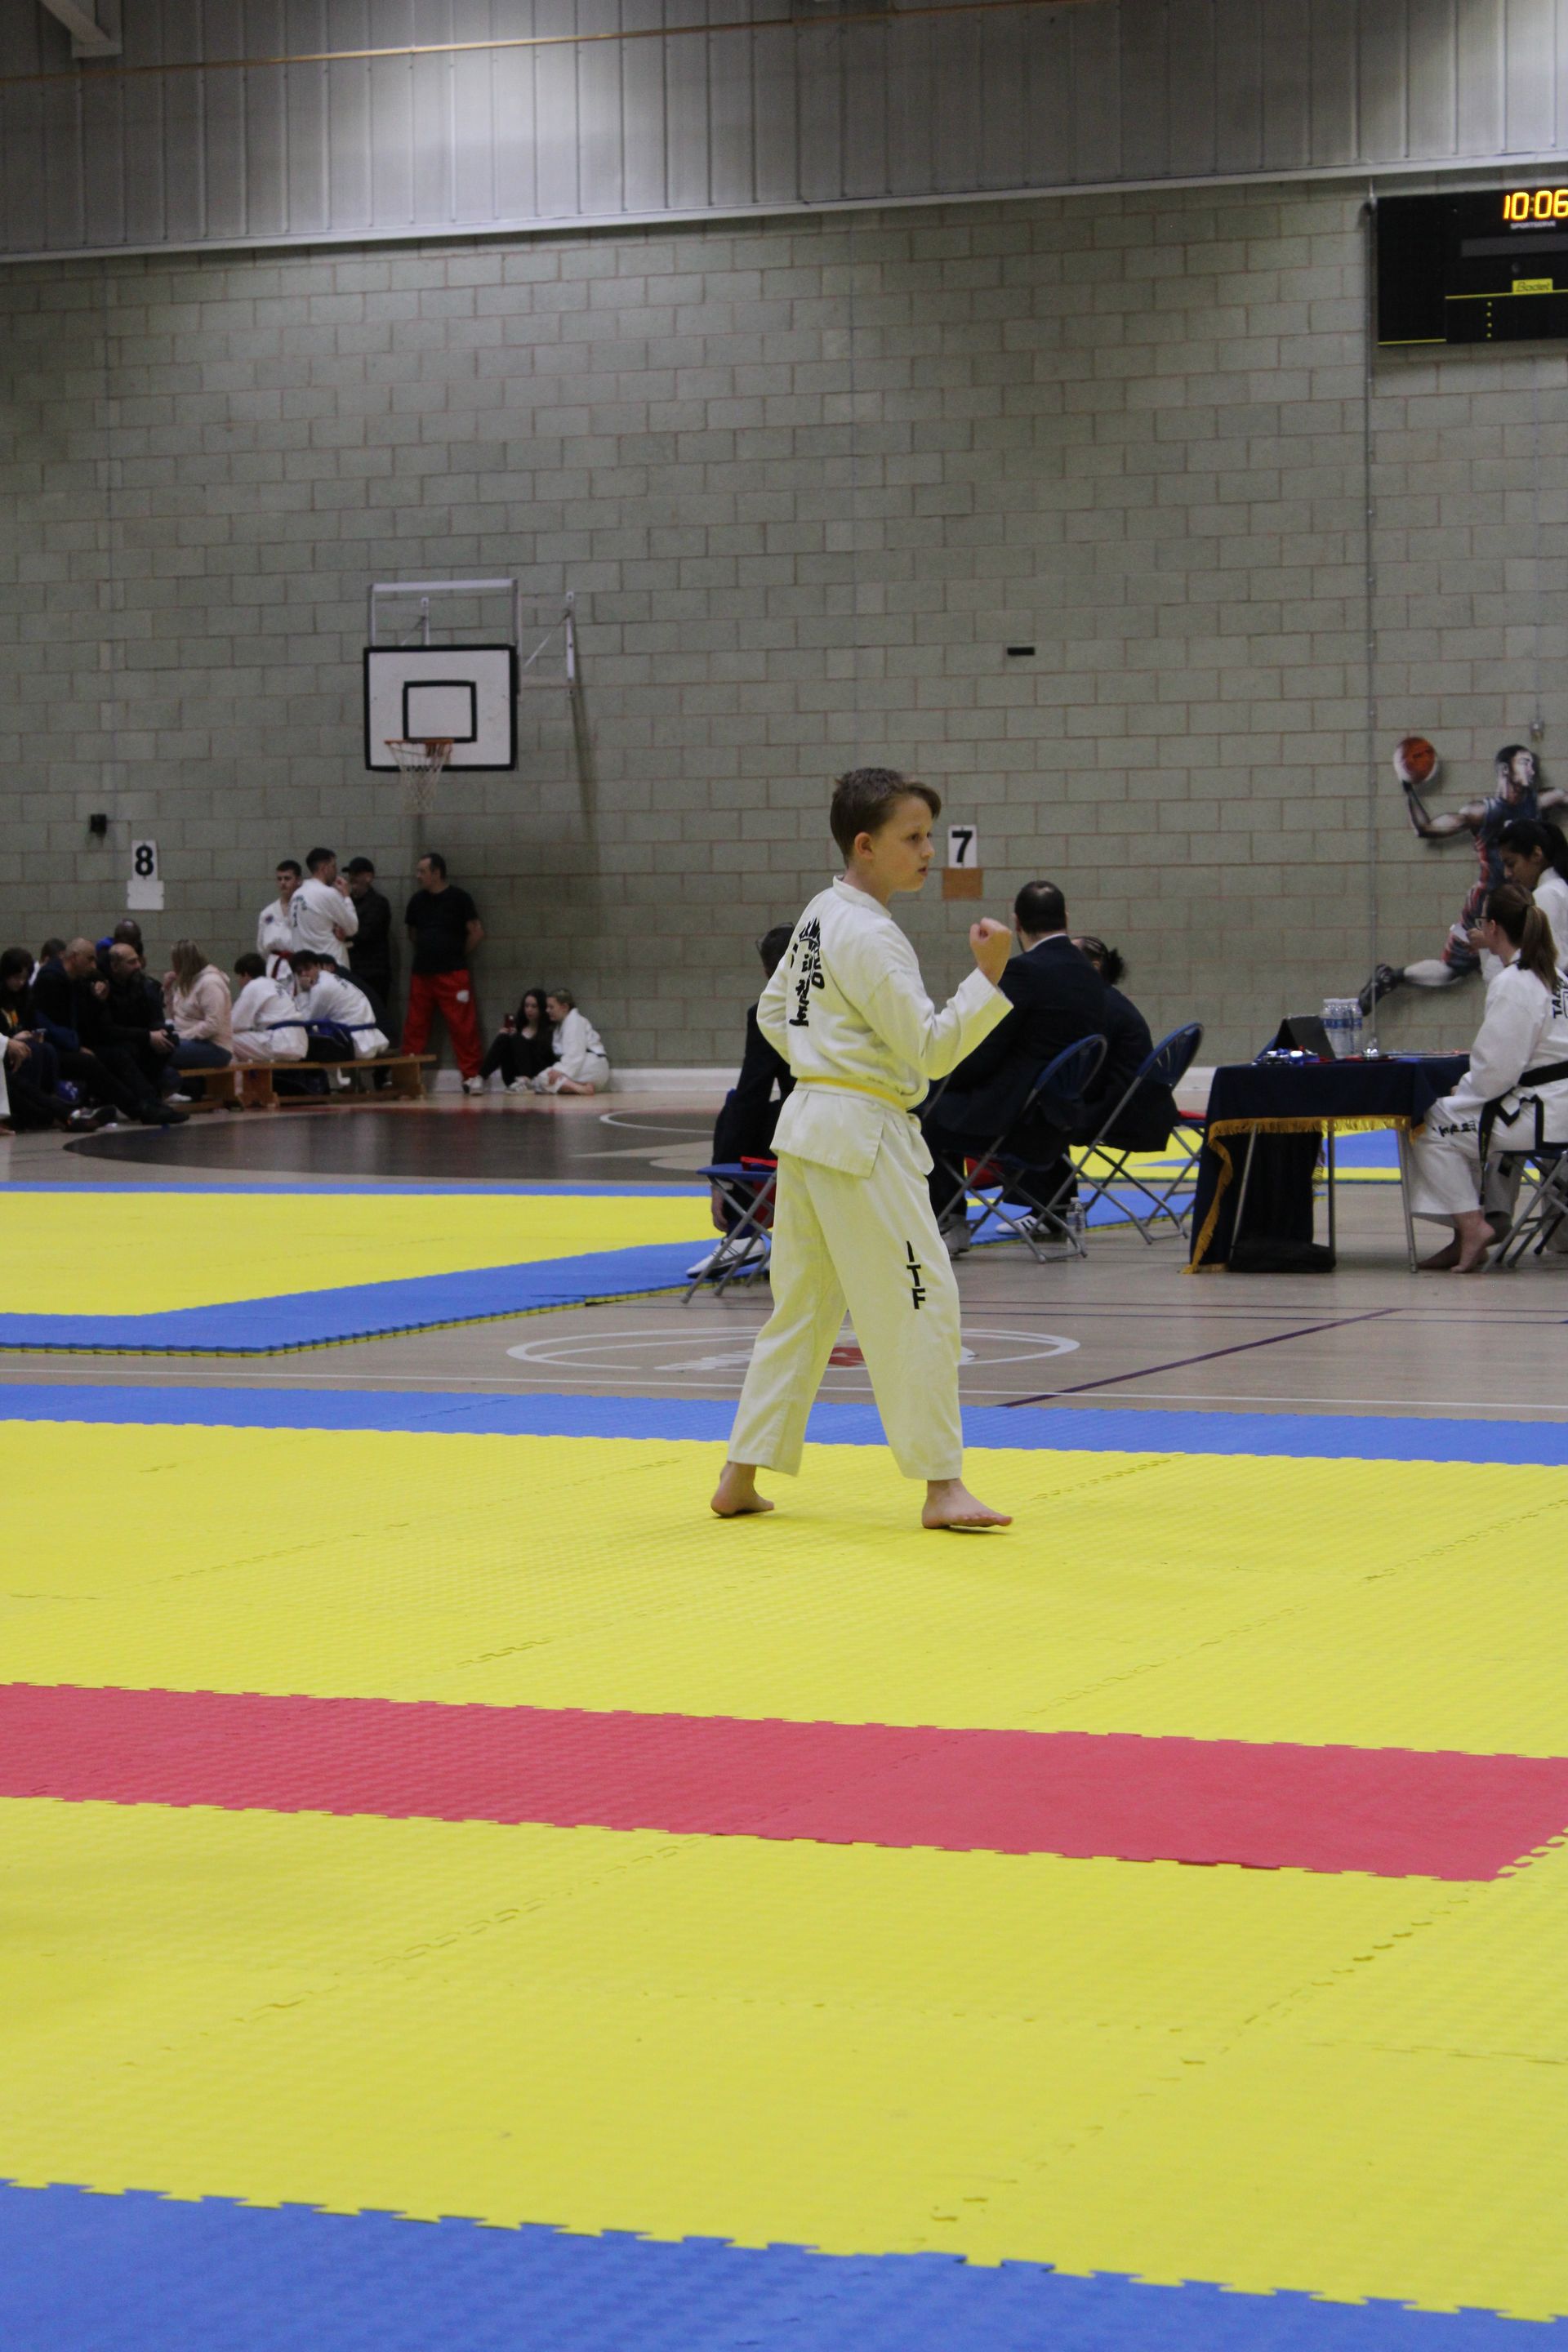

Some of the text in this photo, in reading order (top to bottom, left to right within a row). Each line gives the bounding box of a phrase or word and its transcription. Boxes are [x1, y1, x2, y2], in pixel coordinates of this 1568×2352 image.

[1503, 189, 1568, 220] 10:06
[135, 844, 154, 876] 8
[951, 830, 973, 863] 7
[906, 1241, 925, 1310] ITF
